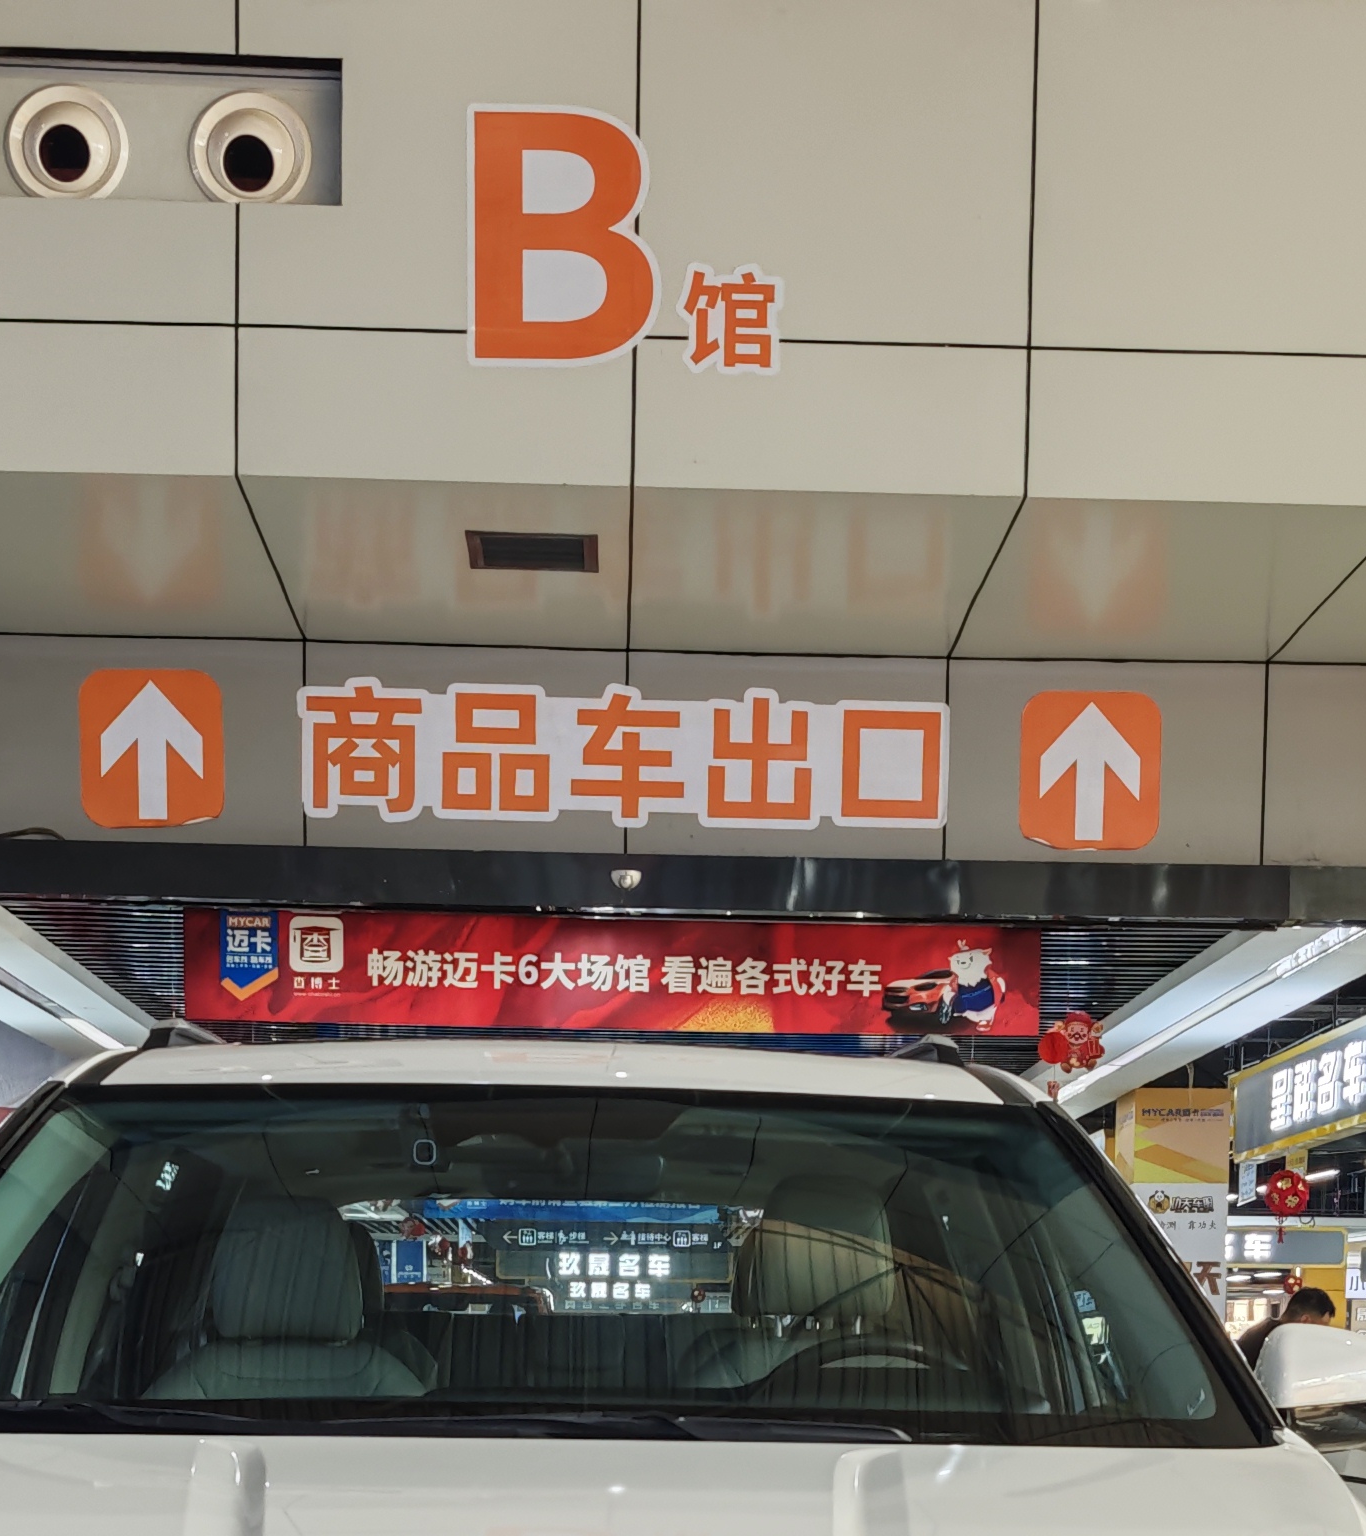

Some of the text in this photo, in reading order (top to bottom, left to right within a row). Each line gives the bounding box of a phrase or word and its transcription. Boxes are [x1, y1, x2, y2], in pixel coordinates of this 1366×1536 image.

[302, 684, 944, 824] 商品车出口
[227, 916, 270, 928] MYCAR
[226, 928, 272, 953] 迈卡
[366, 947, 884, 999] 畅游迈卡6大场馆 看遍各式好车
[637, 1232, 671, 1243] 接待中心
[691, 1232, 709, 1243] 客梯
[558, 1252, 671, 1277] 玖晟名车
[569, 1282, 651, 1299] 玖晟名车
